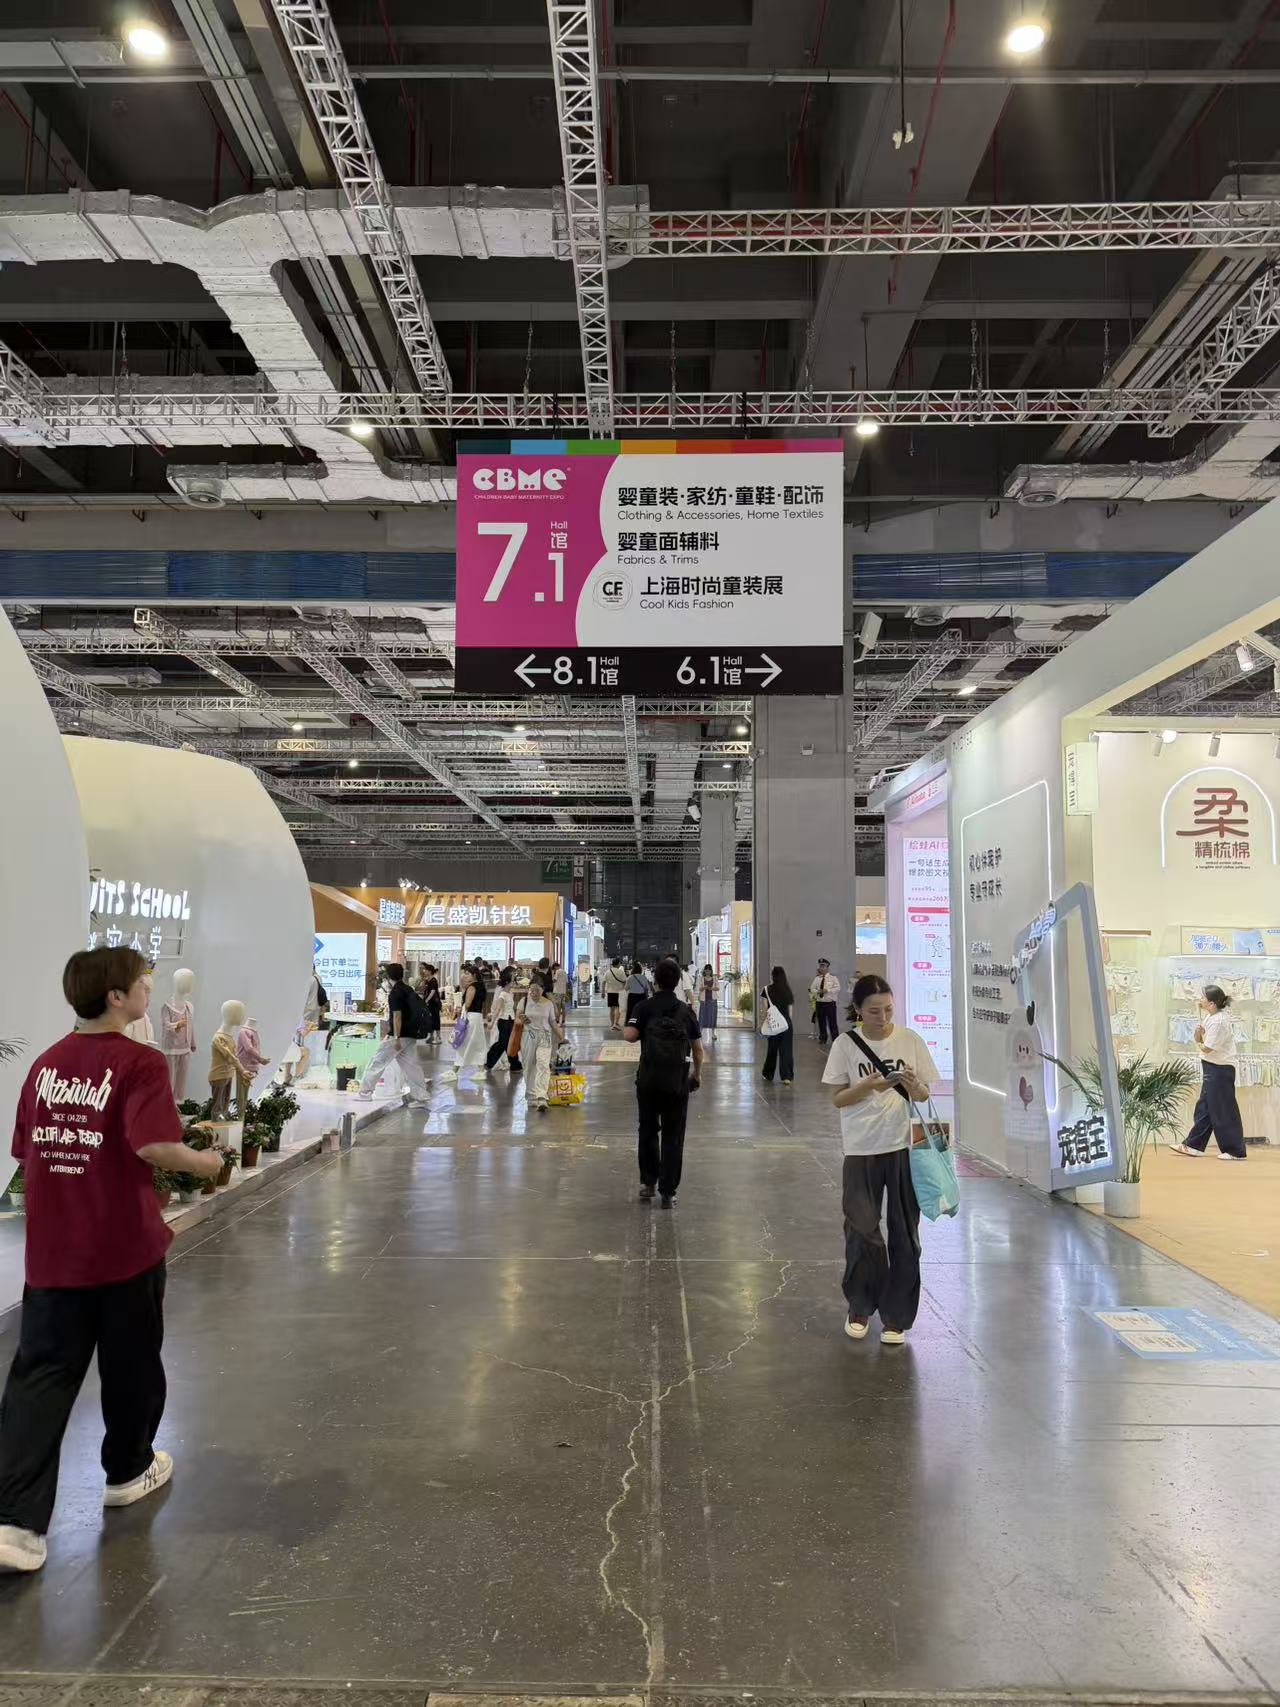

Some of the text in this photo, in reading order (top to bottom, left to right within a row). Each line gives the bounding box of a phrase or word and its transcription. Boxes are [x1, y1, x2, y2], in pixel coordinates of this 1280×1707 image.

[617, 508, 824, 522] Clothing & Accessories, Home Textiles
[550, 521, 568, 530] Hall
[550, 531, 568, 550] 馆
[617, 531, 720, 552] 婴童面辅料
[477, 522, 564, 602] 7.1
[617, 554, 699, 565] Fabrics & Trims
[640, 575, 784, 597] 上海时尚童装展
[640, 599, 734, 610] Cool Kids Fashion
[552, 656, 620, 686] 8.1 Hall
[600, 667, 619, 686] 馆
[676, 656, 743, 686] 6.1 Hall
[723, 667, 742, 686] 馆
[1176, 787, 1250, 838] 柔
[1194, 841, 1251, 859] 精梳棉
[448, 904, 531, 925] 盛凯针织
[858, 1058, 907, 1078] NSA
[40, 1150, 50, 1159] NO
